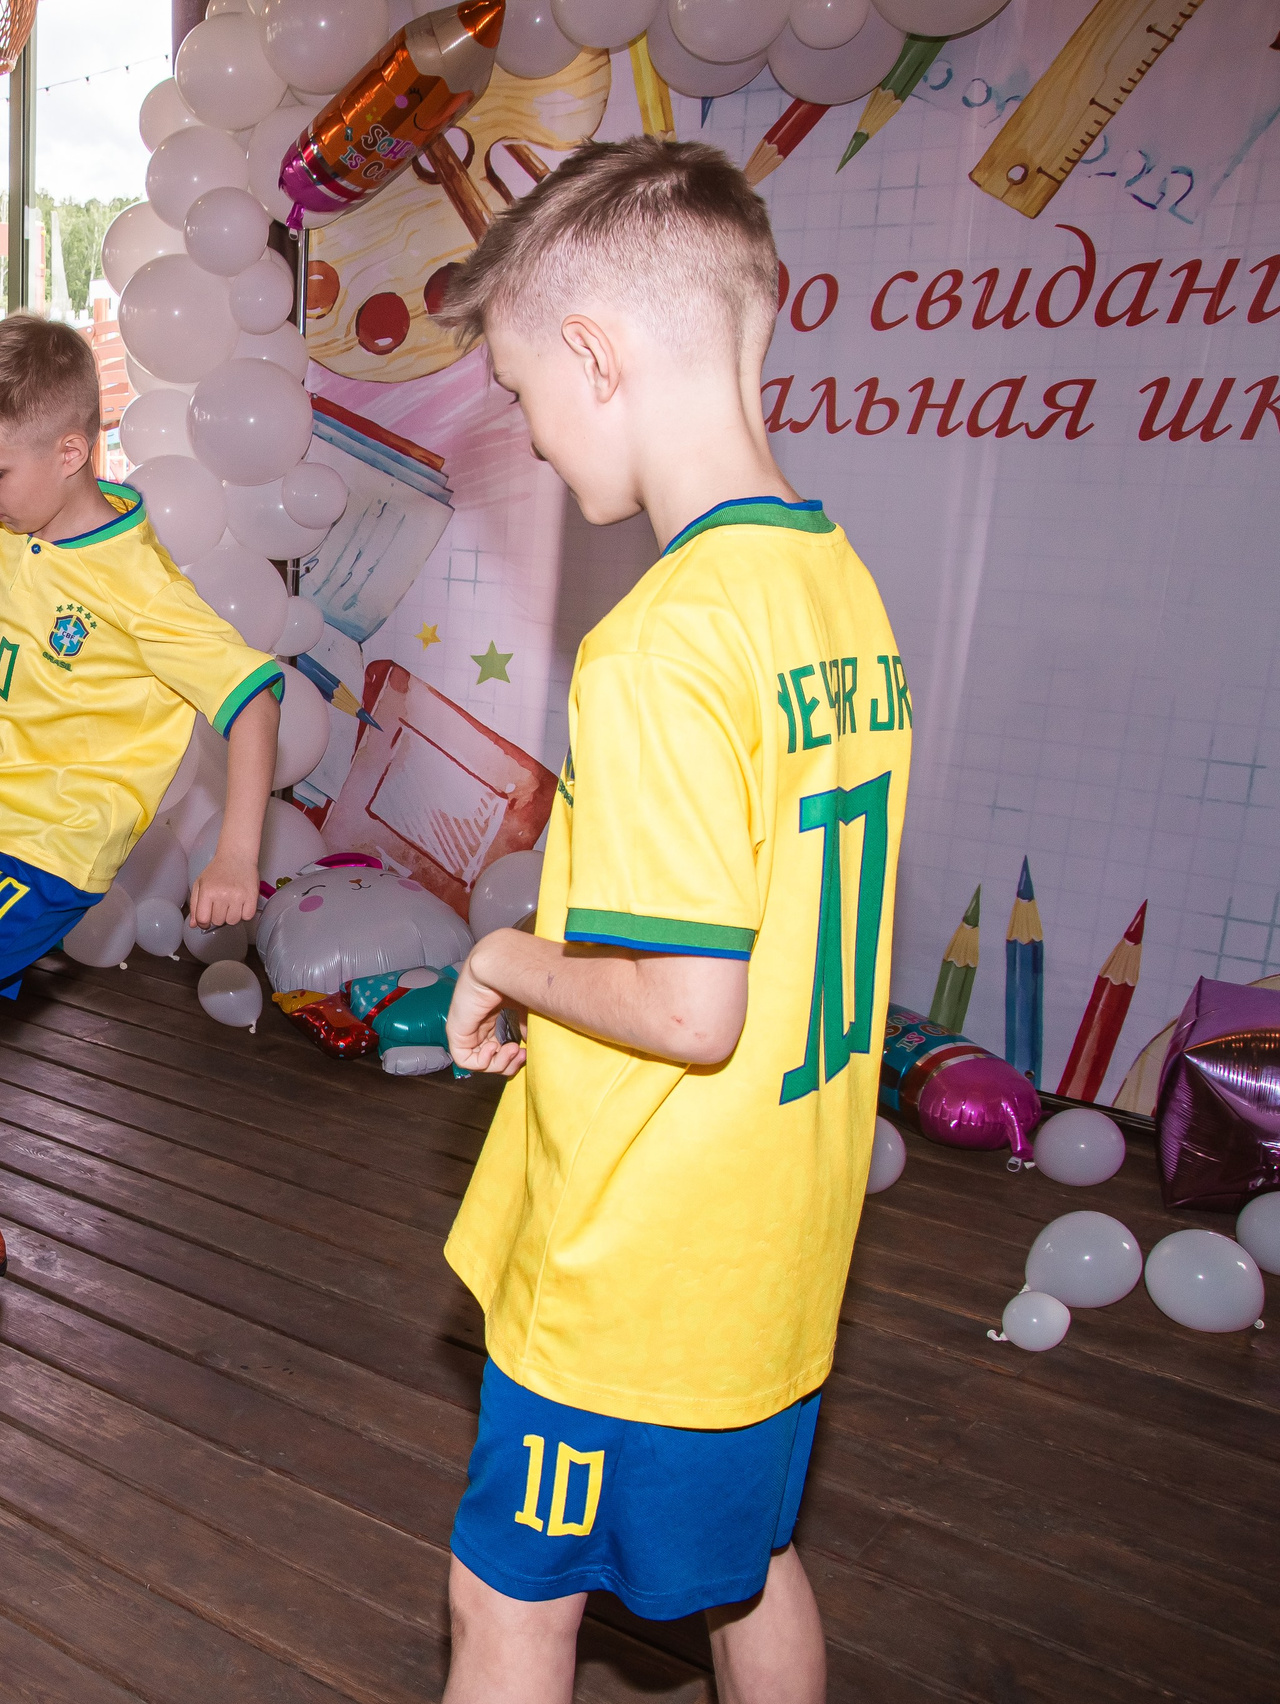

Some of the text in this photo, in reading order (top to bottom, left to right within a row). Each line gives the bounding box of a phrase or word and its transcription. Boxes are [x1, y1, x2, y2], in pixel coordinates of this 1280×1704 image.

[340, 144, 366, 170] IS
[61, 630, 76, 640] CBF
[42, 651, 72, 672] BRASIL
[515, 1434, 605, 1537] 10
